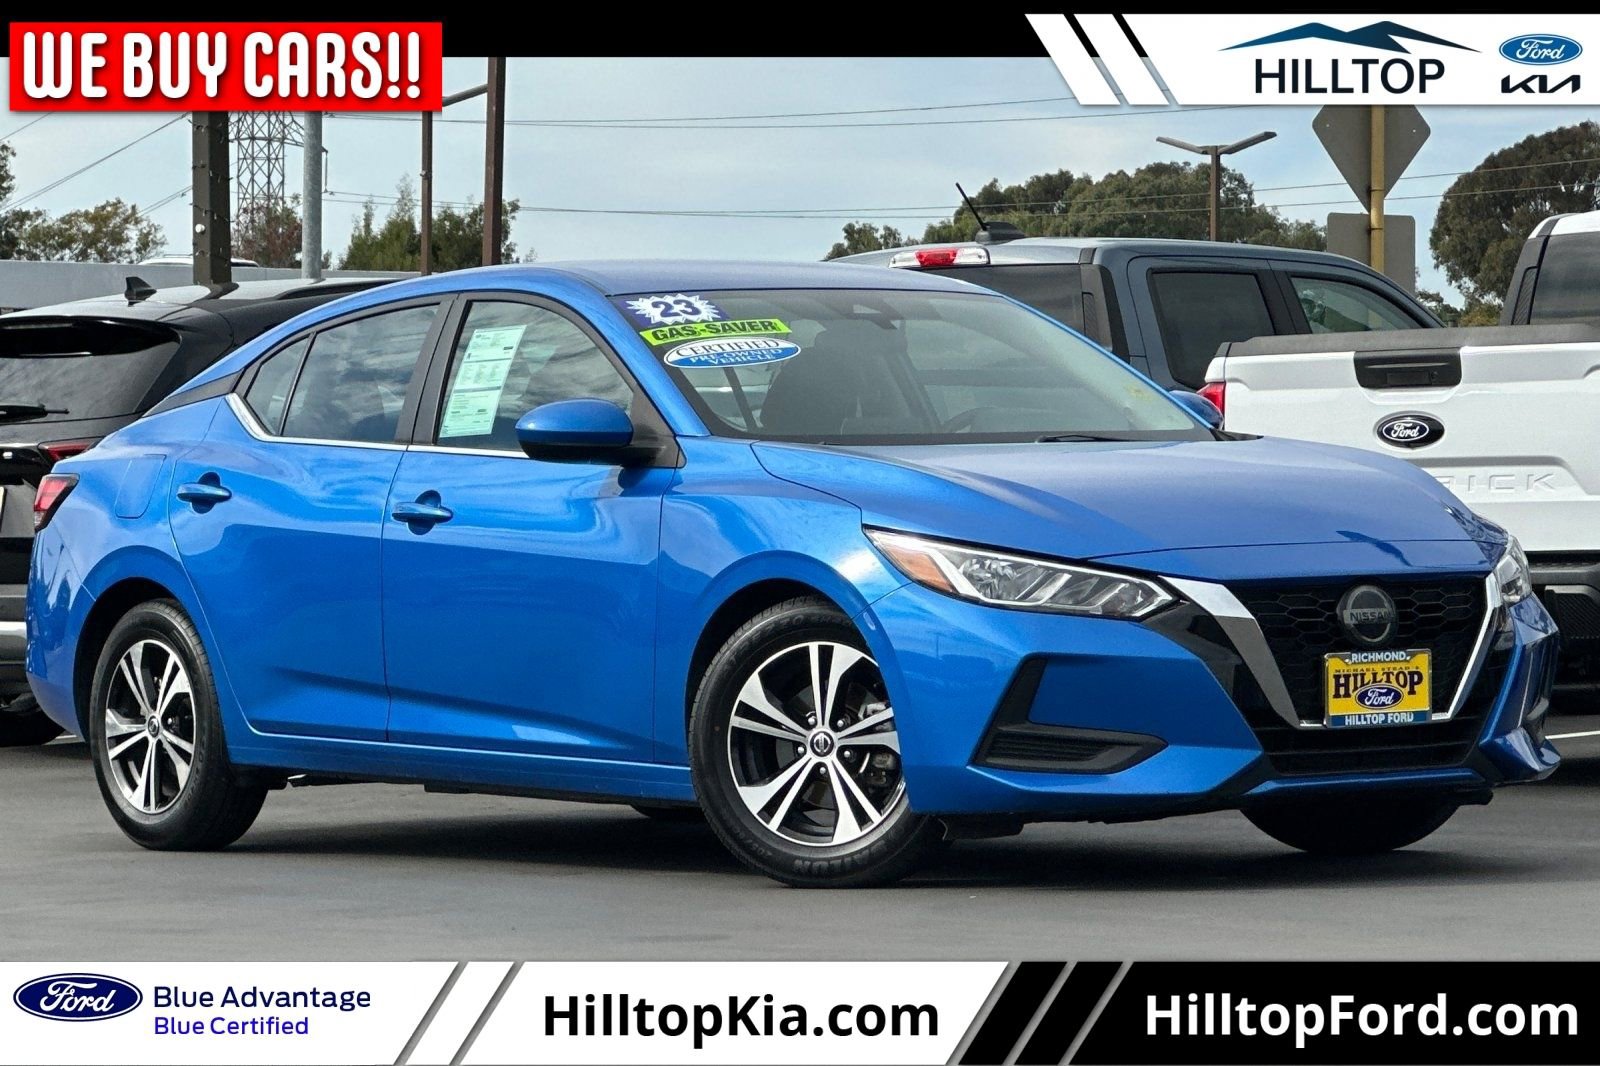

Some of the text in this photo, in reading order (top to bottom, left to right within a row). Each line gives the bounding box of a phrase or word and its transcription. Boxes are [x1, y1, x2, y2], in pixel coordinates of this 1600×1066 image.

[651, 298, 702, 319] 23
[651, 319, 778, 342] GAS-SAVER
[676, 338, 781, 358] CERTIFIED
[689, 348, 783, 363] PRE-OWNED
[708, 354, 776, 366] VEHICLE
[1391, 422, 1420, 438] Ford
[1351, 651, 1406, 663] RICHMOND
[1333, 670, 1423, 699] HILLTOP
[1364, 688, 1395, 705] Ford
[1345, 712, 1414, 726] HILLTOP FORD
